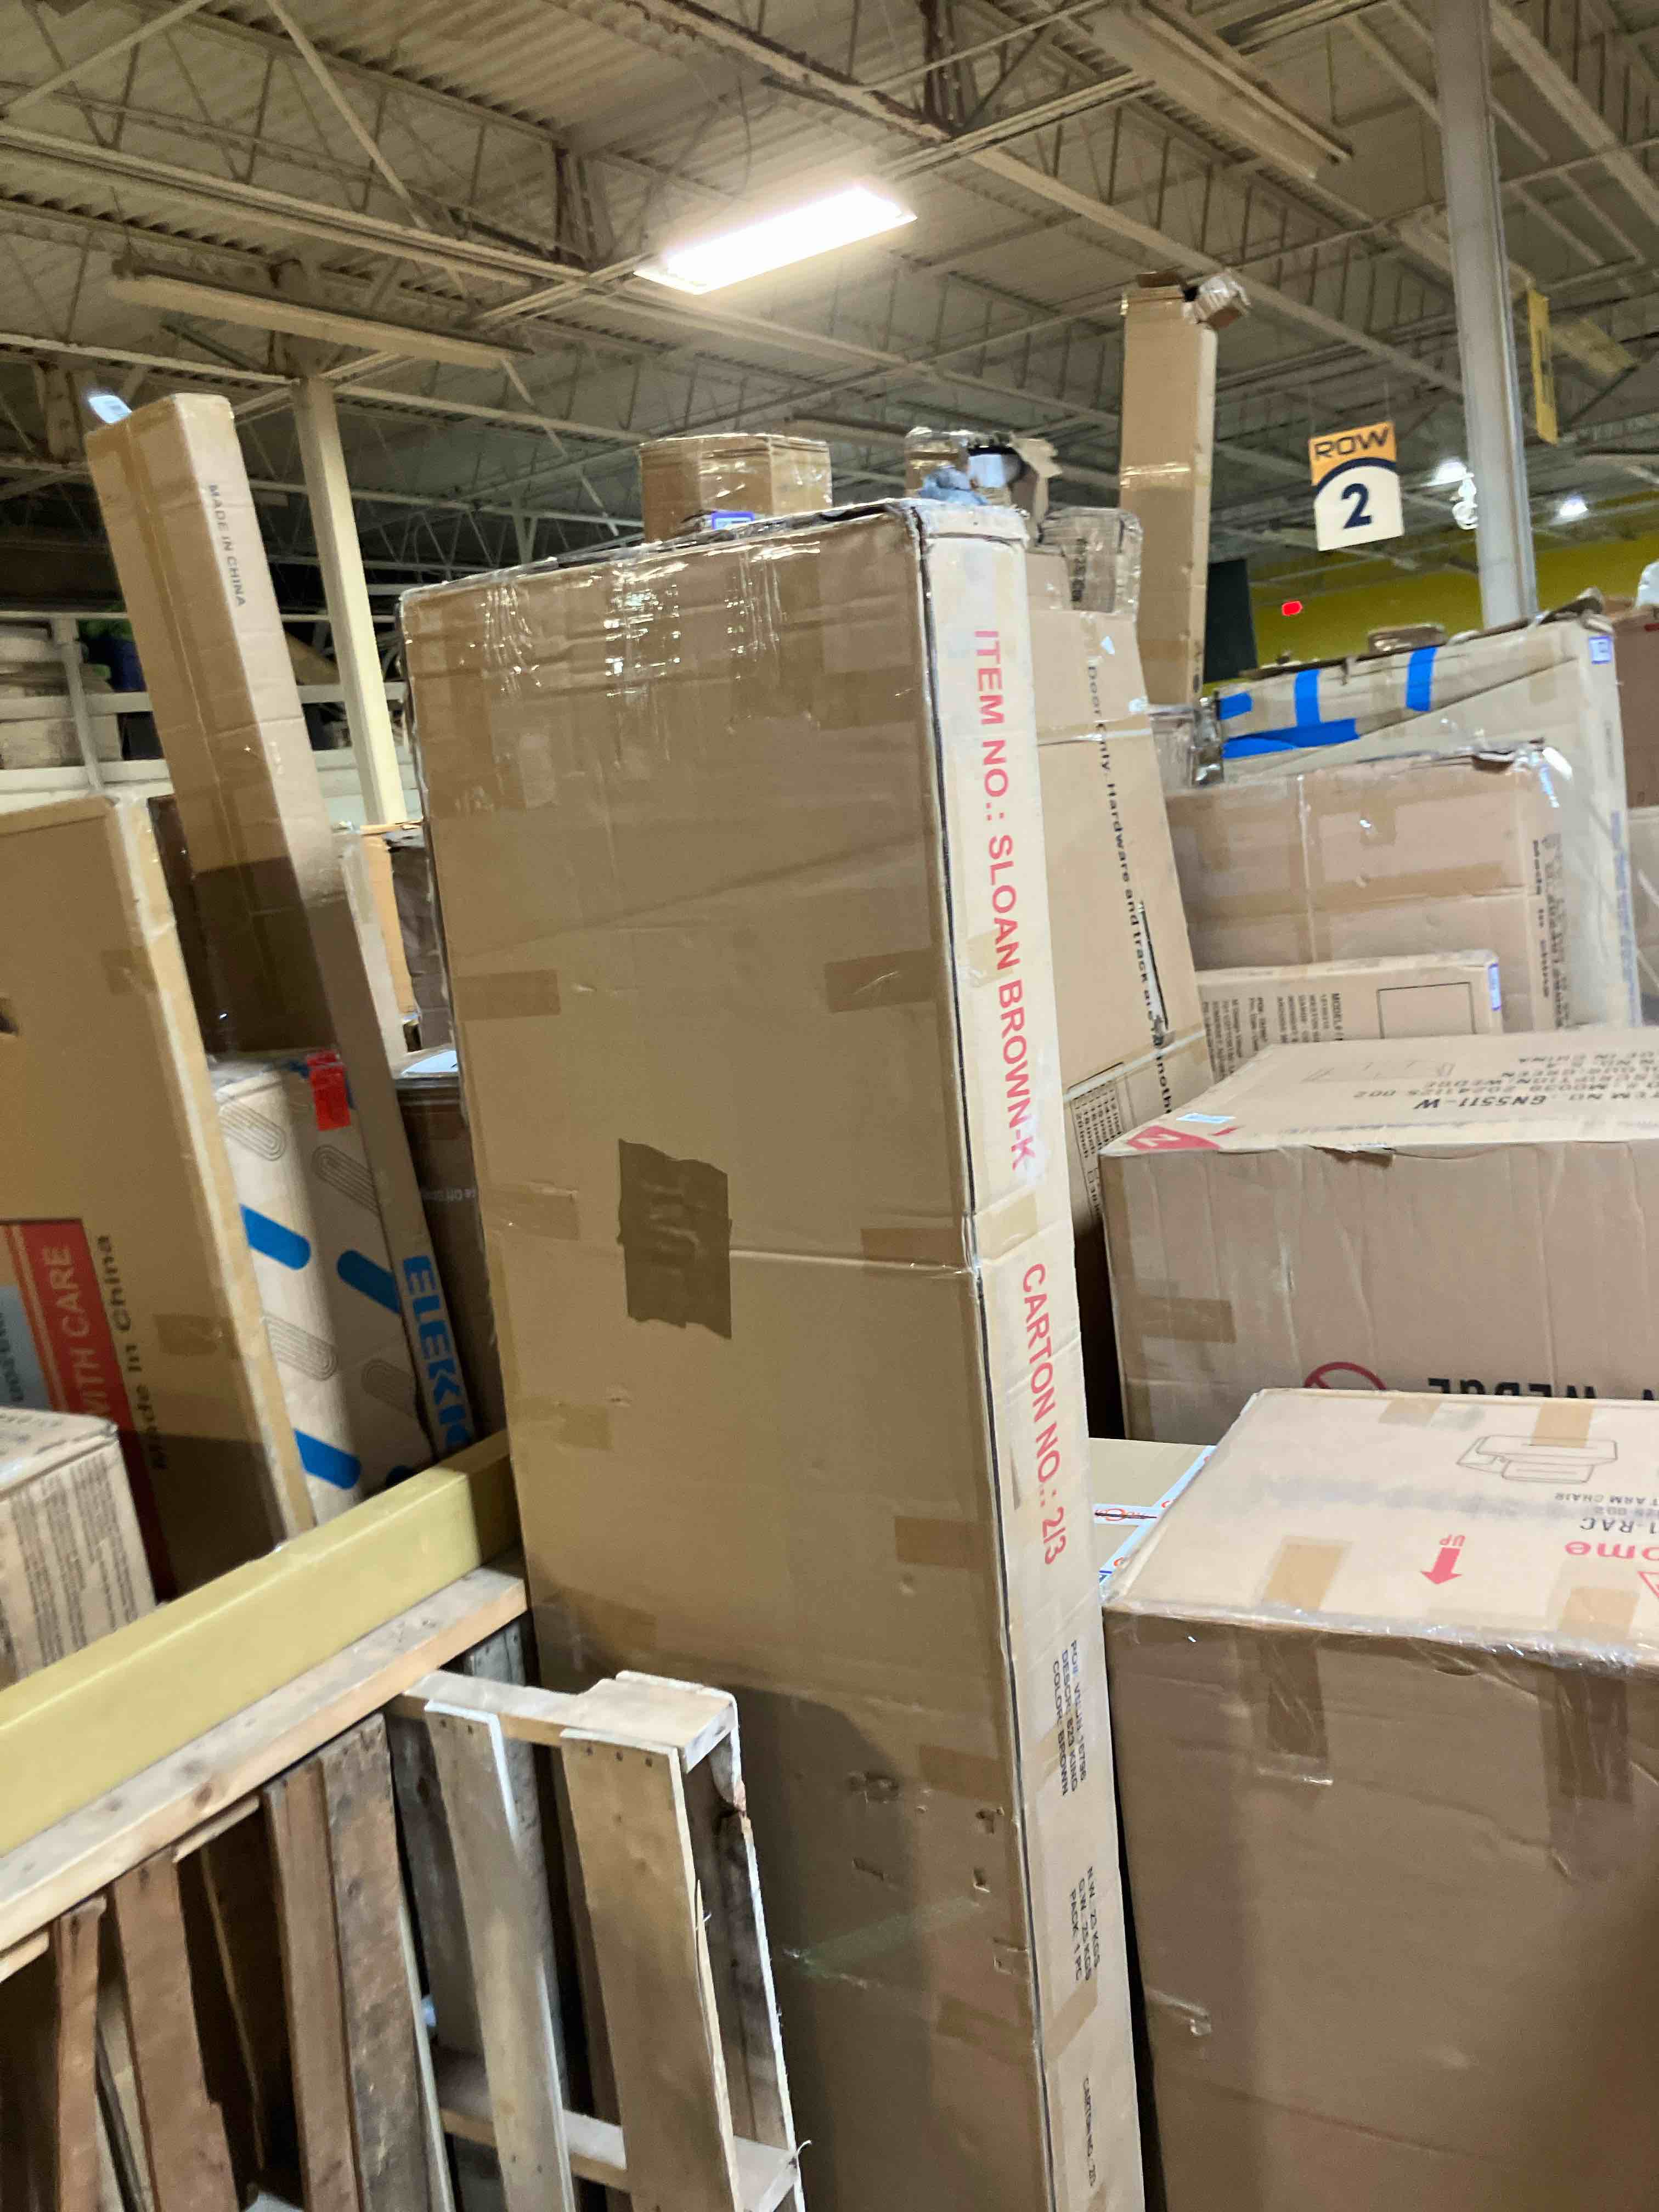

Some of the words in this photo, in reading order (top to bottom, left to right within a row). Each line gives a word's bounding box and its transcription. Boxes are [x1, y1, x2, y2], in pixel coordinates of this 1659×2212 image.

[1313, 426, 1391, 461] ROW
[208, 484, 229, 531] MADE
[1341, 483, 1373, 529] 2
[222, 536, 234, 551] IN
[227, 556, 246, 606] CHINA
[974, 630, 1005, 725] ITEM
[981, 738, 1009, 821] NO.:
[1088, 665, 1102, 716] Door
[1107, 782, 1130, 882] Hardware
[1125, 888, 1140, 926] and
[1134, 933, 1149, 984] track
[988, 834, 1021, 970] SLOAN
[998, 979, 1036, 1171] BROWN-K
[42, 1244, 91, 1339] CARE
[97, 1235, 132, 1333] China
[1023, 1263, 1056, 1422] CARTON
[1035, 1422, 1061, 1507] NO.:
[1555, 1492, 1605, 1504] CHAIR
[1609, 1494, 1647, 1505] ARM
[1042, 1506, 1066, 1565] 2/3
[1438, 1534, 1466, 1547] UP
[1057, 1730, 1069, 1796] BROWN
